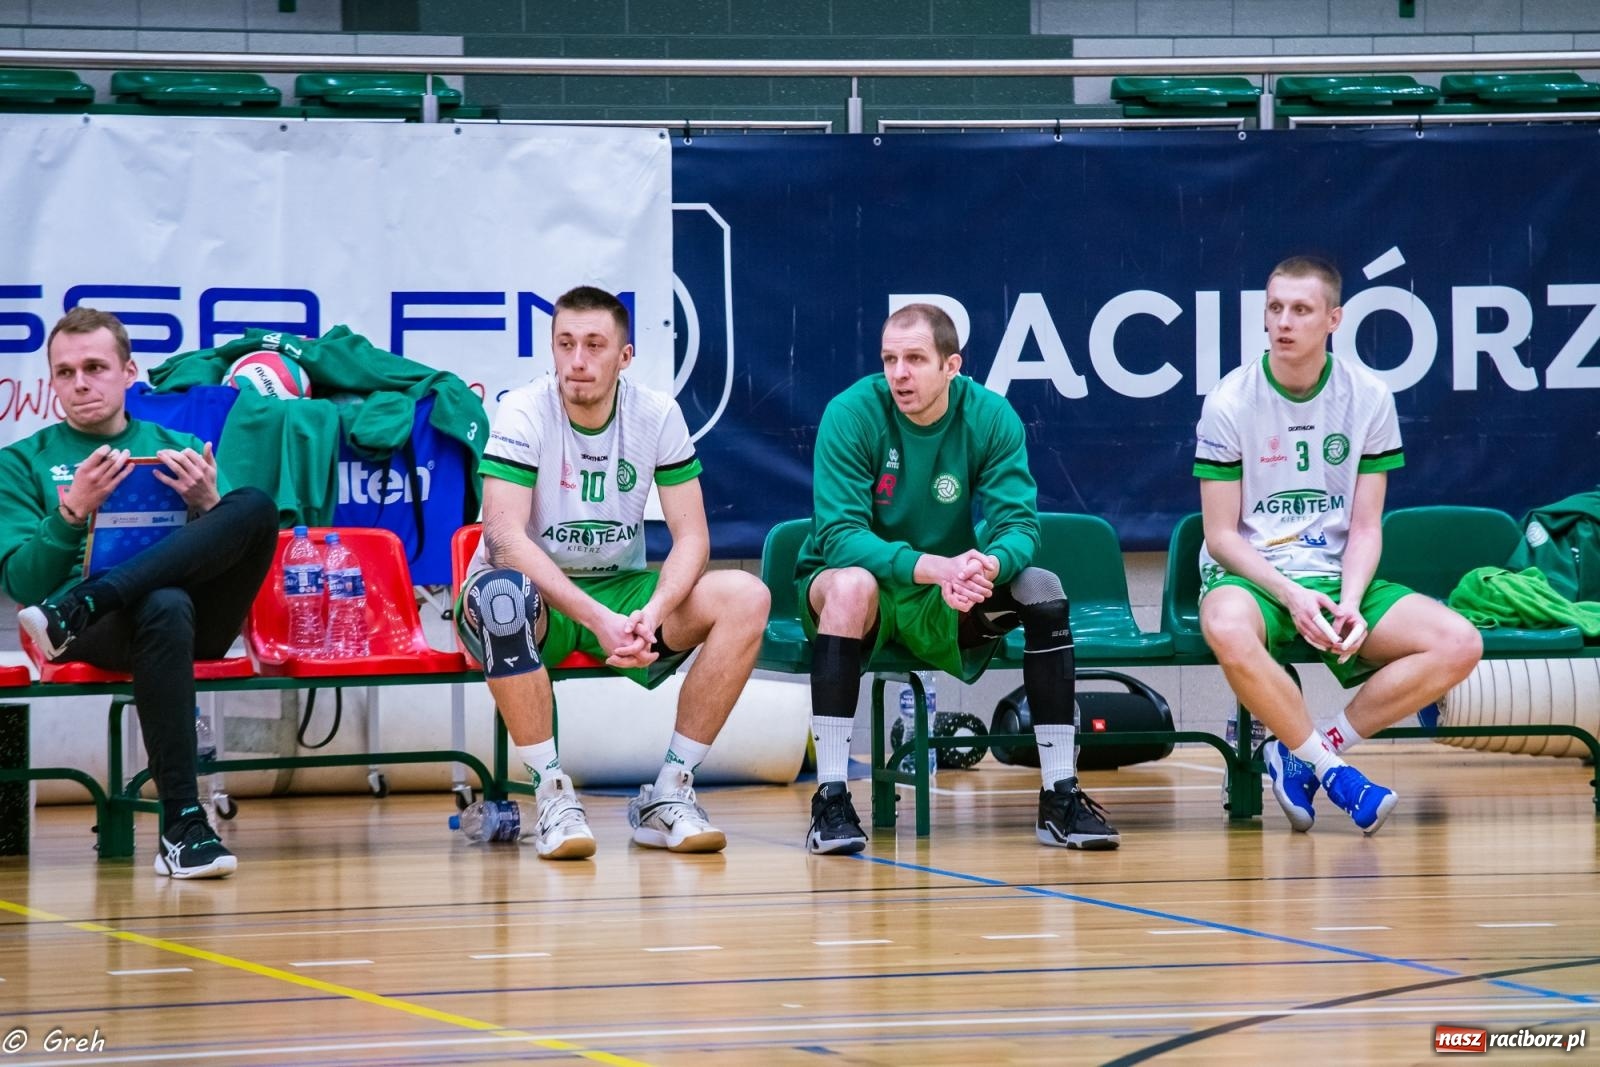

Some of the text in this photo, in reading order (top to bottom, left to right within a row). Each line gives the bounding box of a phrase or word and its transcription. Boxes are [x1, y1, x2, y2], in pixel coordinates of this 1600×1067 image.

[888, 246, 1600, 399] ACIÓRZ
[467, 421, 478, 441] 3
[1296, 440, 1310, 472] 3
[337, 461, 431, 505] lten
[580, 469, 606, 502] 10
[541, 523, 638, 546] AGROTEAM
[567, 545, 601, 554] KIETRZ
